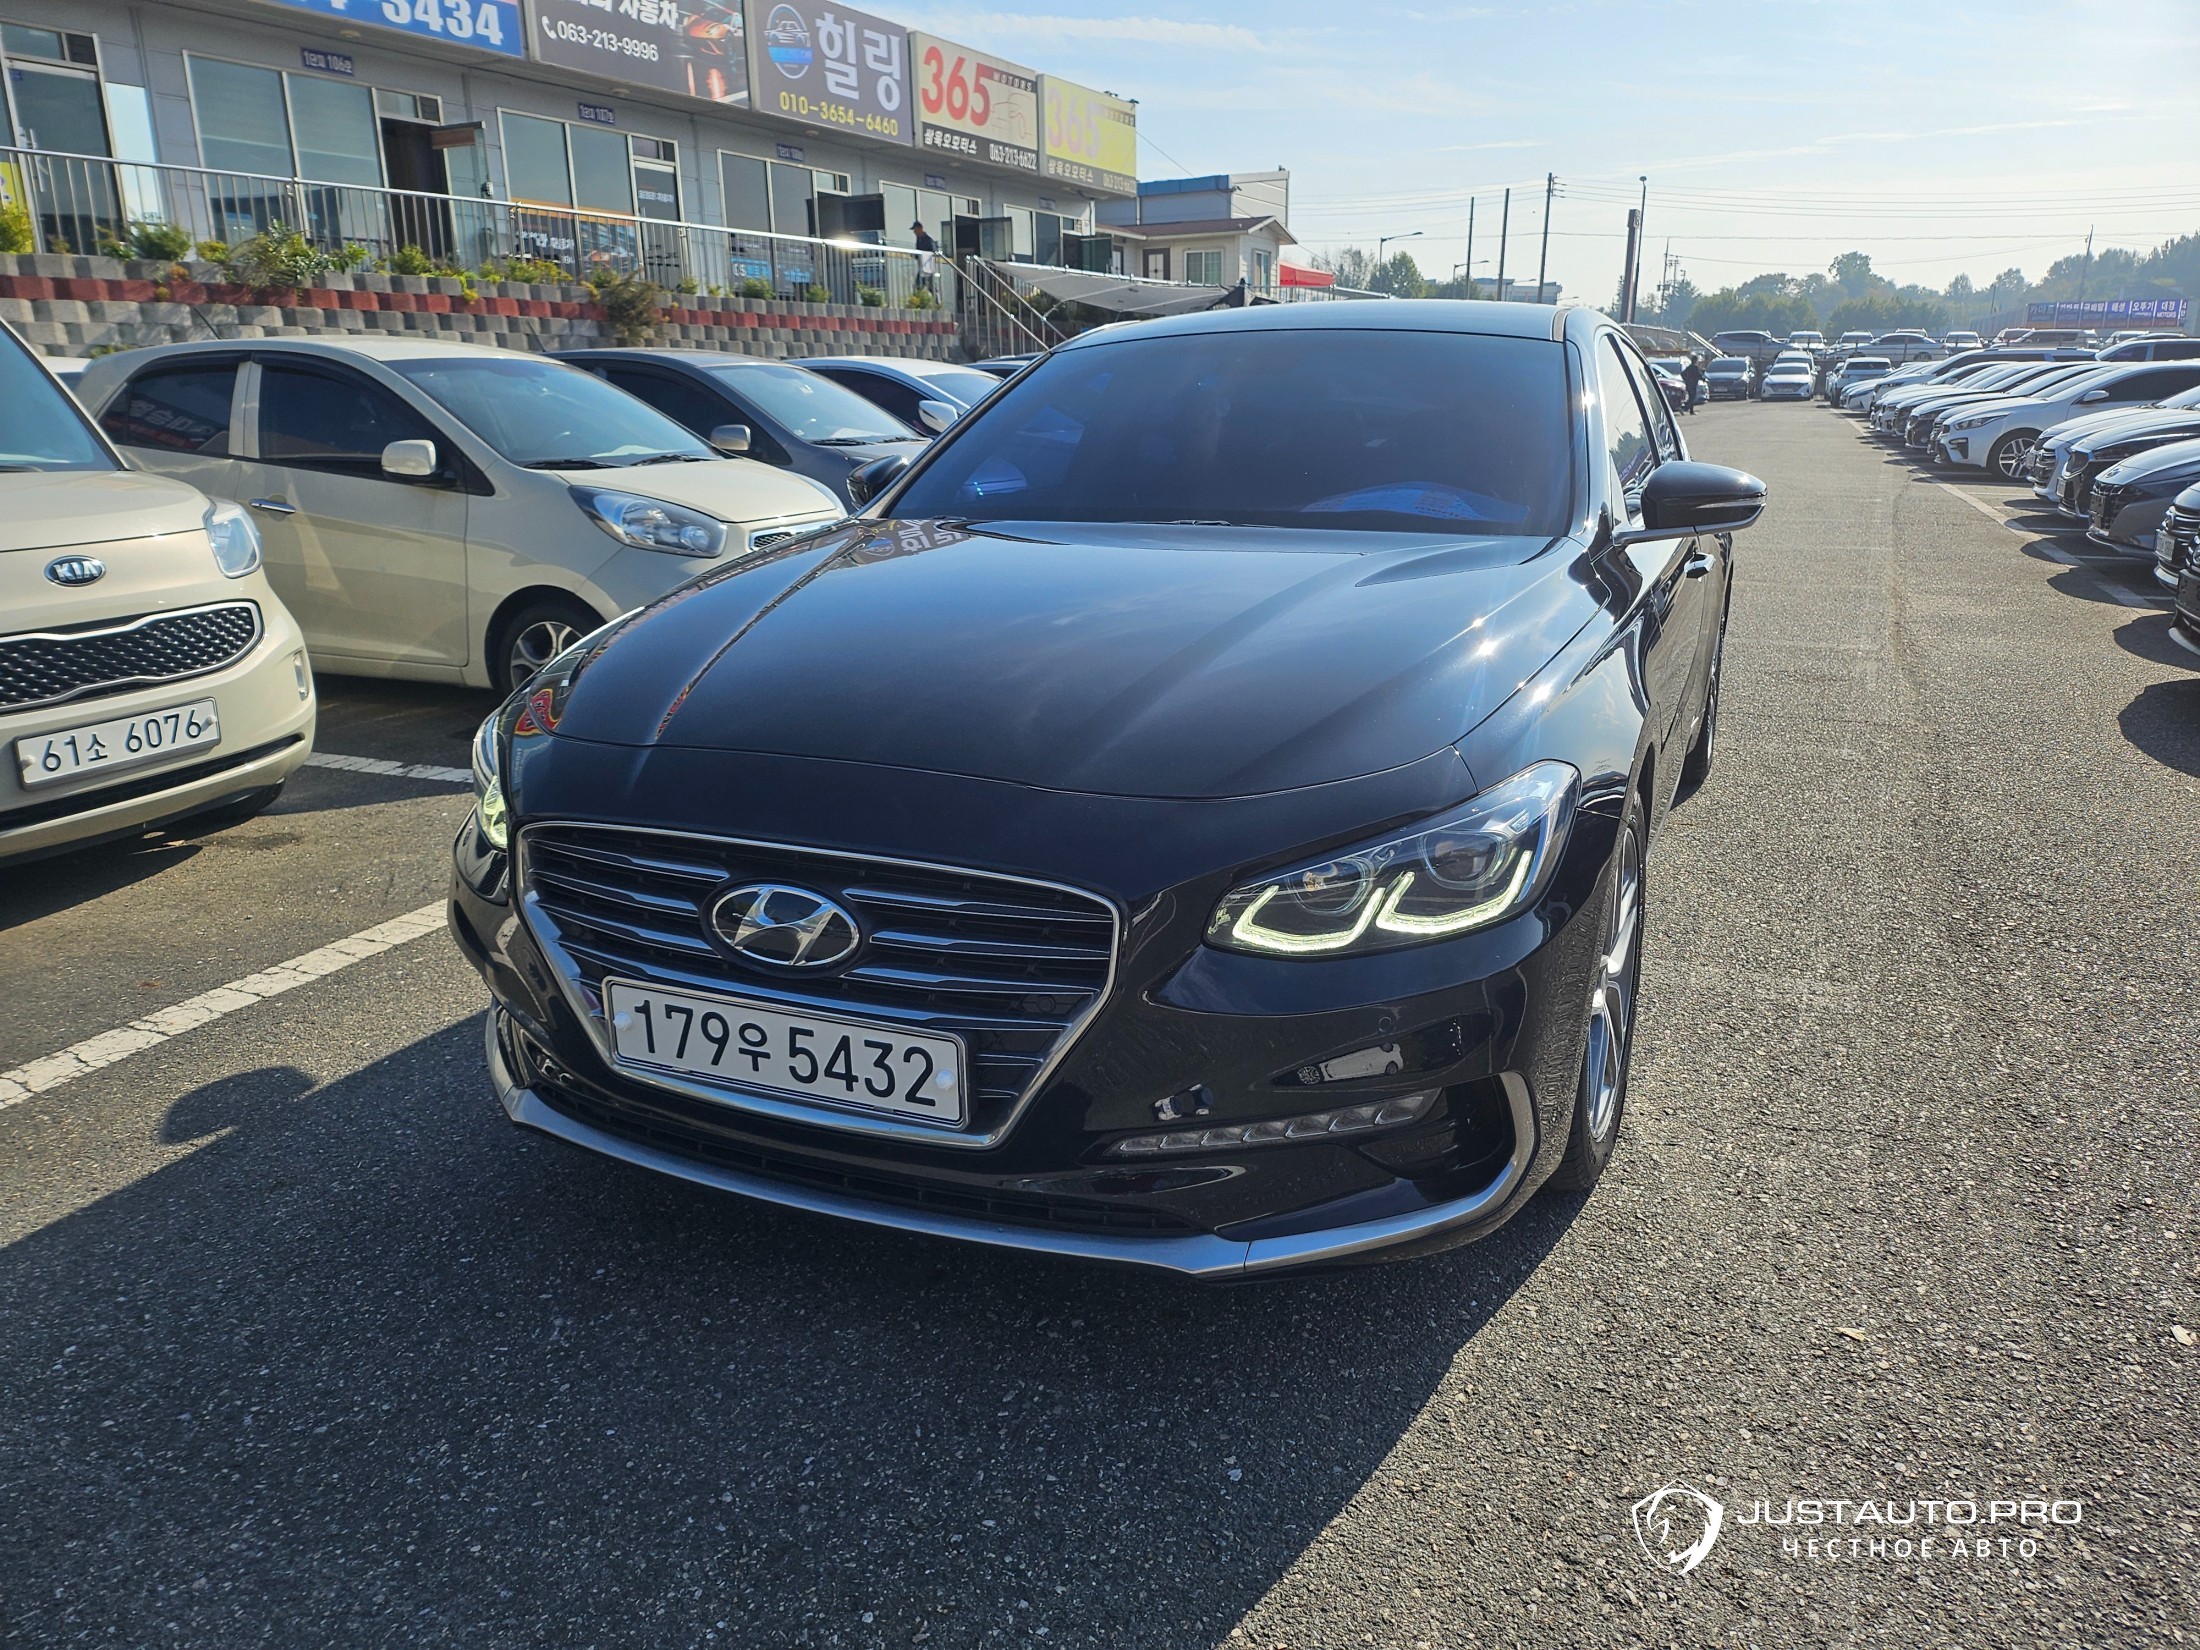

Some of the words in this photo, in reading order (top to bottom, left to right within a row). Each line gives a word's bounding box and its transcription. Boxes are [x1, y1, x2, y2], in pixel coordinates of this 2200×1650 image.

[556, 20, 660, 61] 063-213-9996
[815, 12, 900, 112] 힐링
[779, 91, 899, 137] 010-3654-6460
[921, 45, 991, 126] 365
[1047, 86, 1100, 158] 365
[53, 560, 99, 580] KIA
[41, 733, 109, 773] 61소
[125, 708, 202, 753] 6076
[634, 999, 771, 1073] 179우
[787, 1028, 937, 1107] 5432
